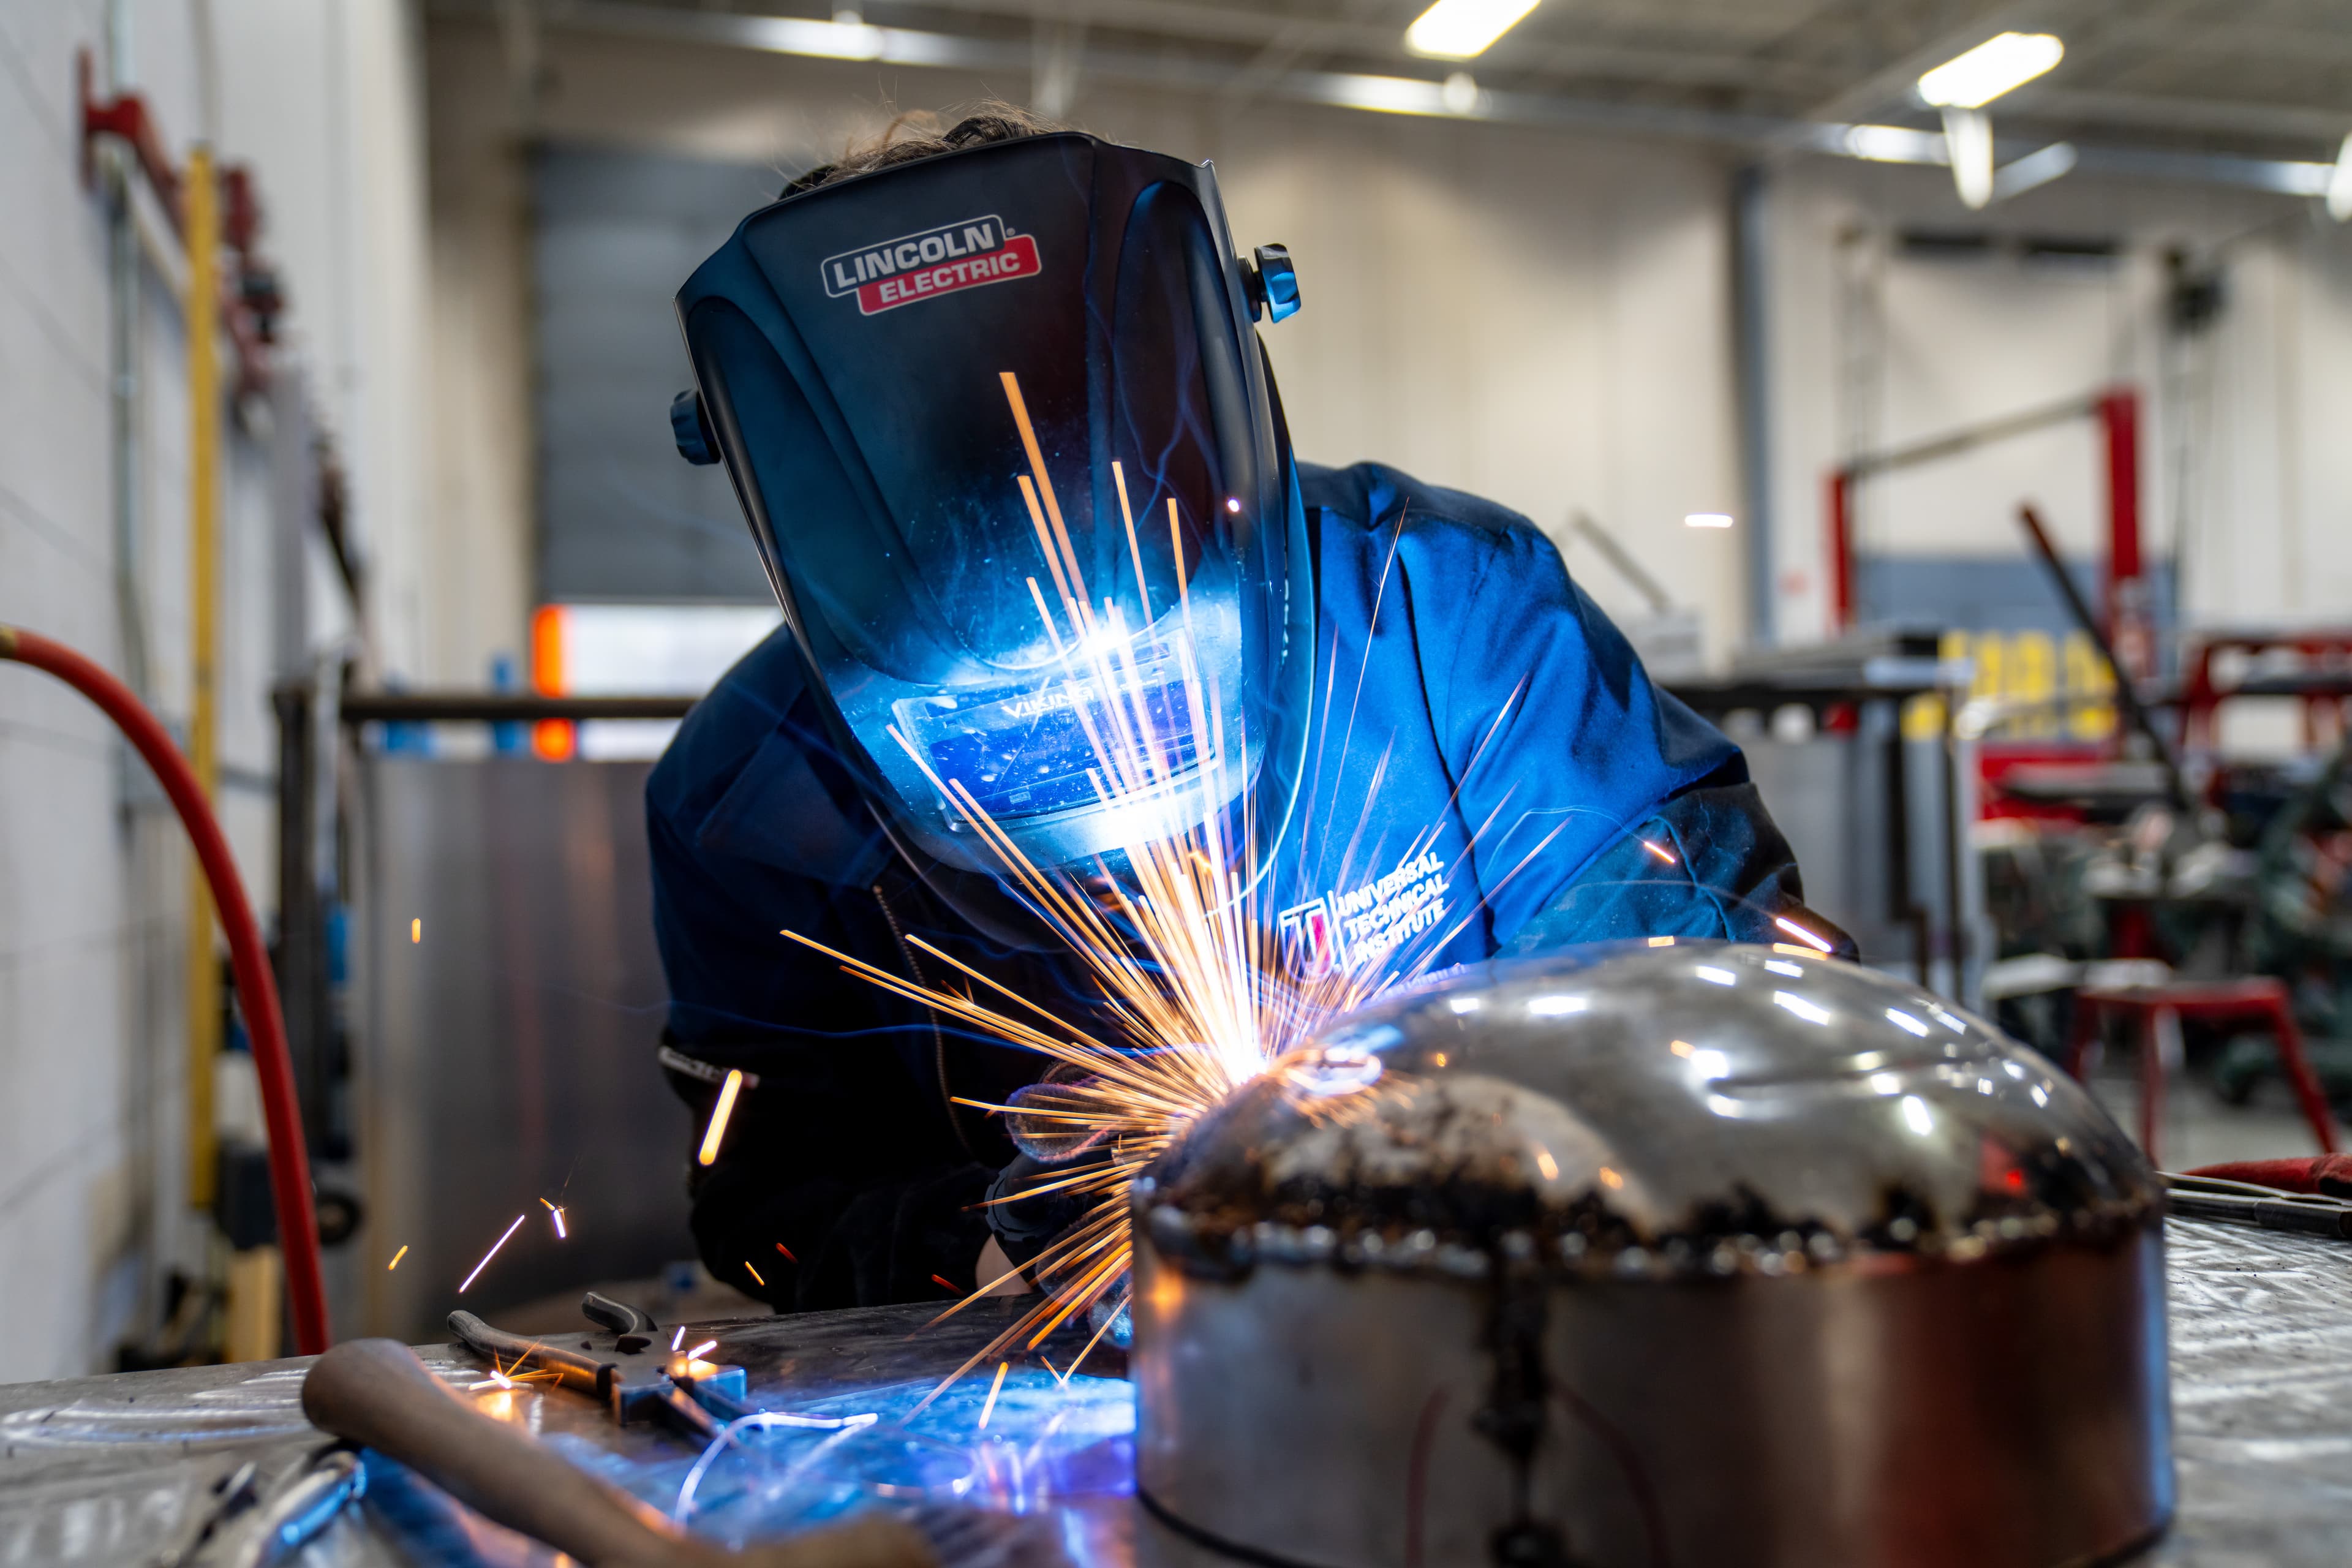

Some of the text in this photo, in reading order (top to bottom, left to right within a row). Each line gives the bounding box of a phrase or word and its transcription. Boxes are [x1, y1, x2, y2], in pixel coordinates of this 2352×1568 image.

[834, 223, 995, 289] LINCOLN
[878, 252, 1020, 304] ELECTRIC
[1001, 686, 1095, 719] VIKING
[1336, 851, 1444, 917] UNIVERSAL
[1344, 873, 1450, 941] TECHNICAL
[1353, 897, 1446, 964] INSTITUTE
